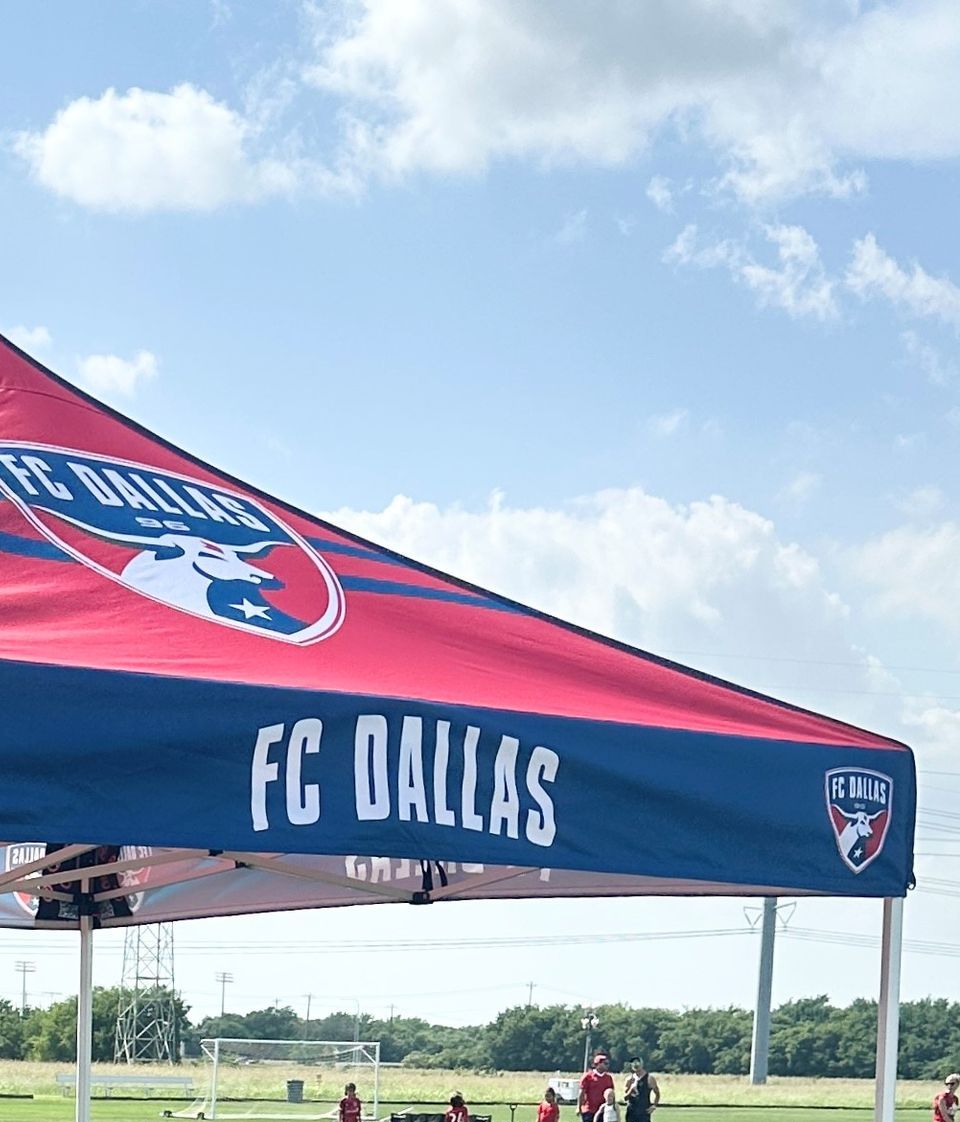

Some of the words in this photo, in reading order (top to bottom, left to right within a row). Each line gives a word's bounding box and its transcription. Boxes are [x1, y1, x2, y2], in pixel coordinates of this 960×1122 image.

[65, 461, 270, 532] DALLAS
[134, 517, 191, 532] 96
[251, 717, 323, 831] FC
[354, 714, 559, 847] DALLAS
[832, 777, 845, 800] FC
[849, 775, 887, 804] DALLAS
